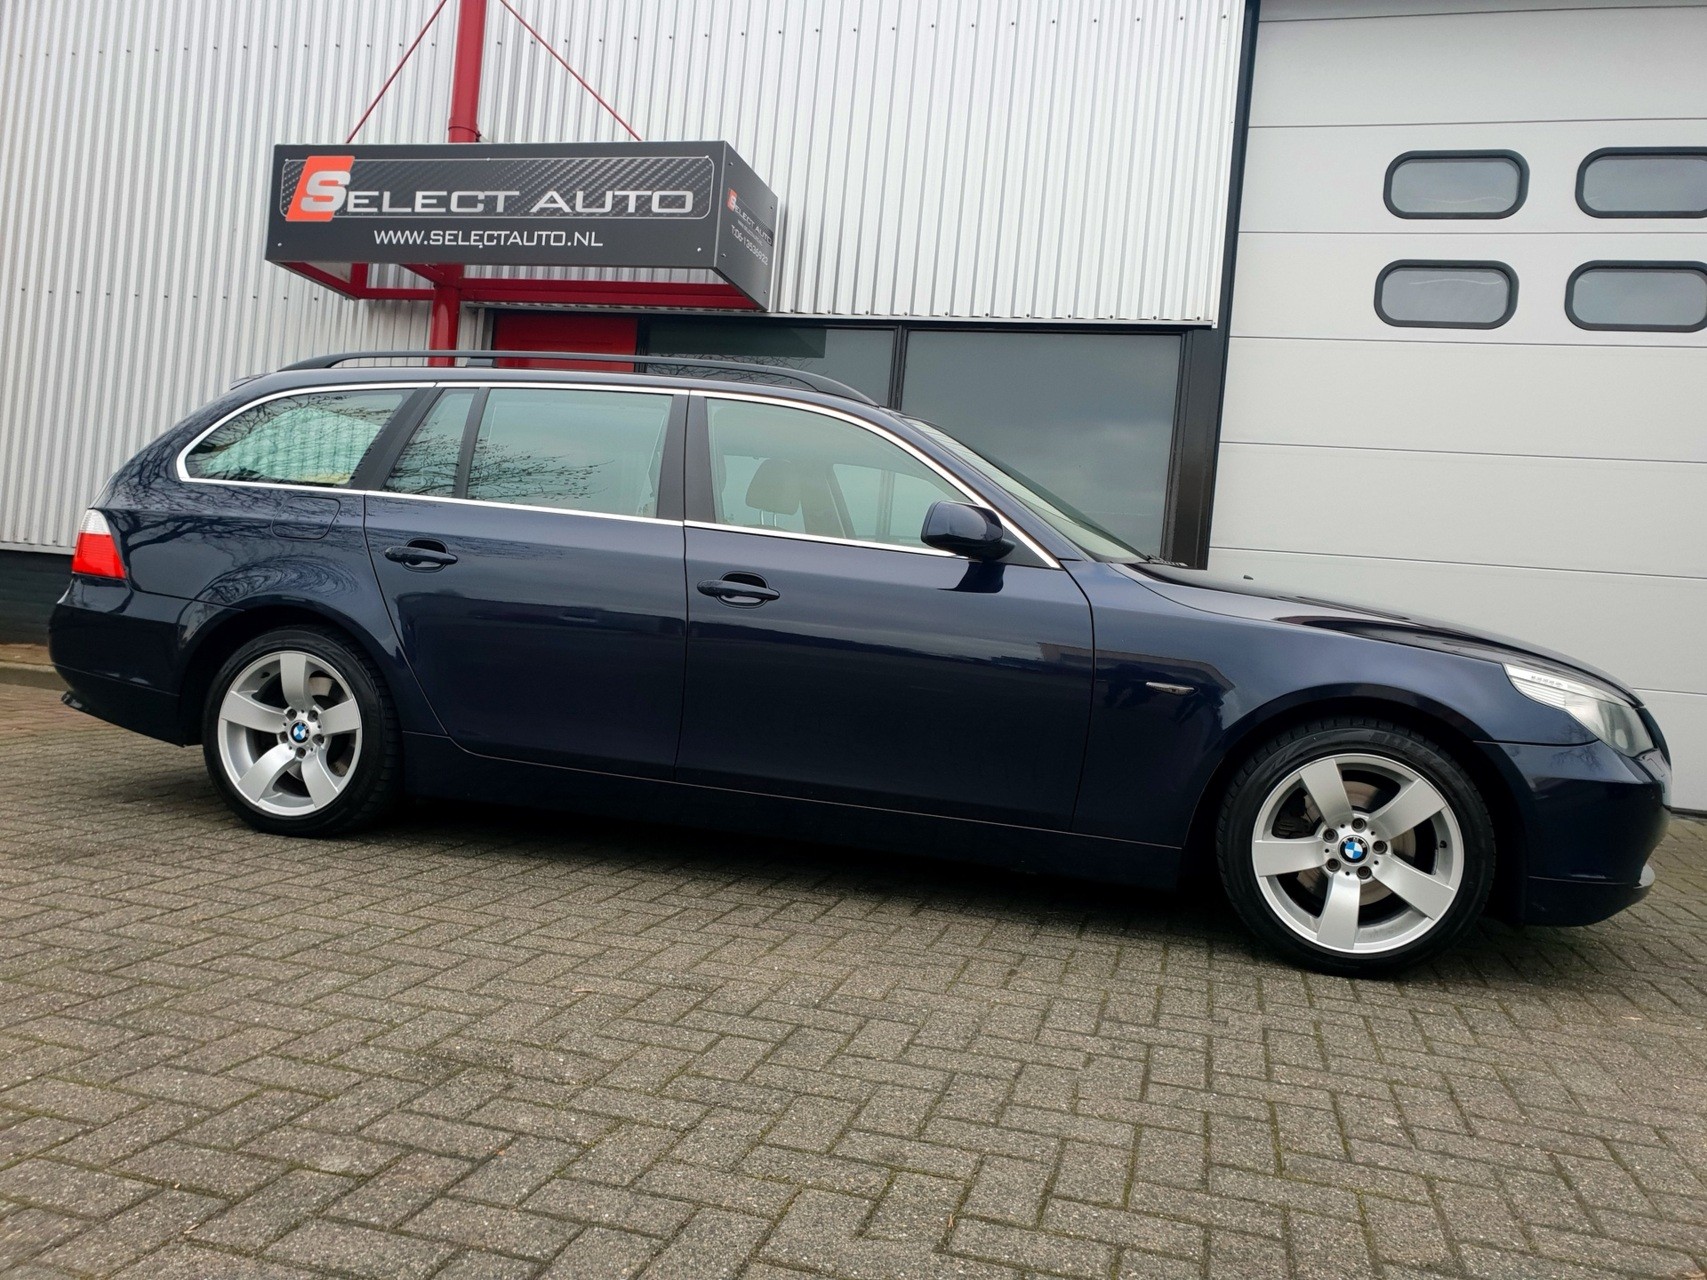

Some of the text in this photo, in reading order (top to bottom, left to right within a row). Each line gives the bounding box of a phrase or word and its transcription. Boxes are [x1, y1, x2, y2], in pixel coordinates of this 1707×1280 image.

[300, 170, 694, 213] SELECT AUTO
[373, 229, 604, 247] WWW.SELECTAUTO.NL
[755, 226, 772, 246] AUTO
